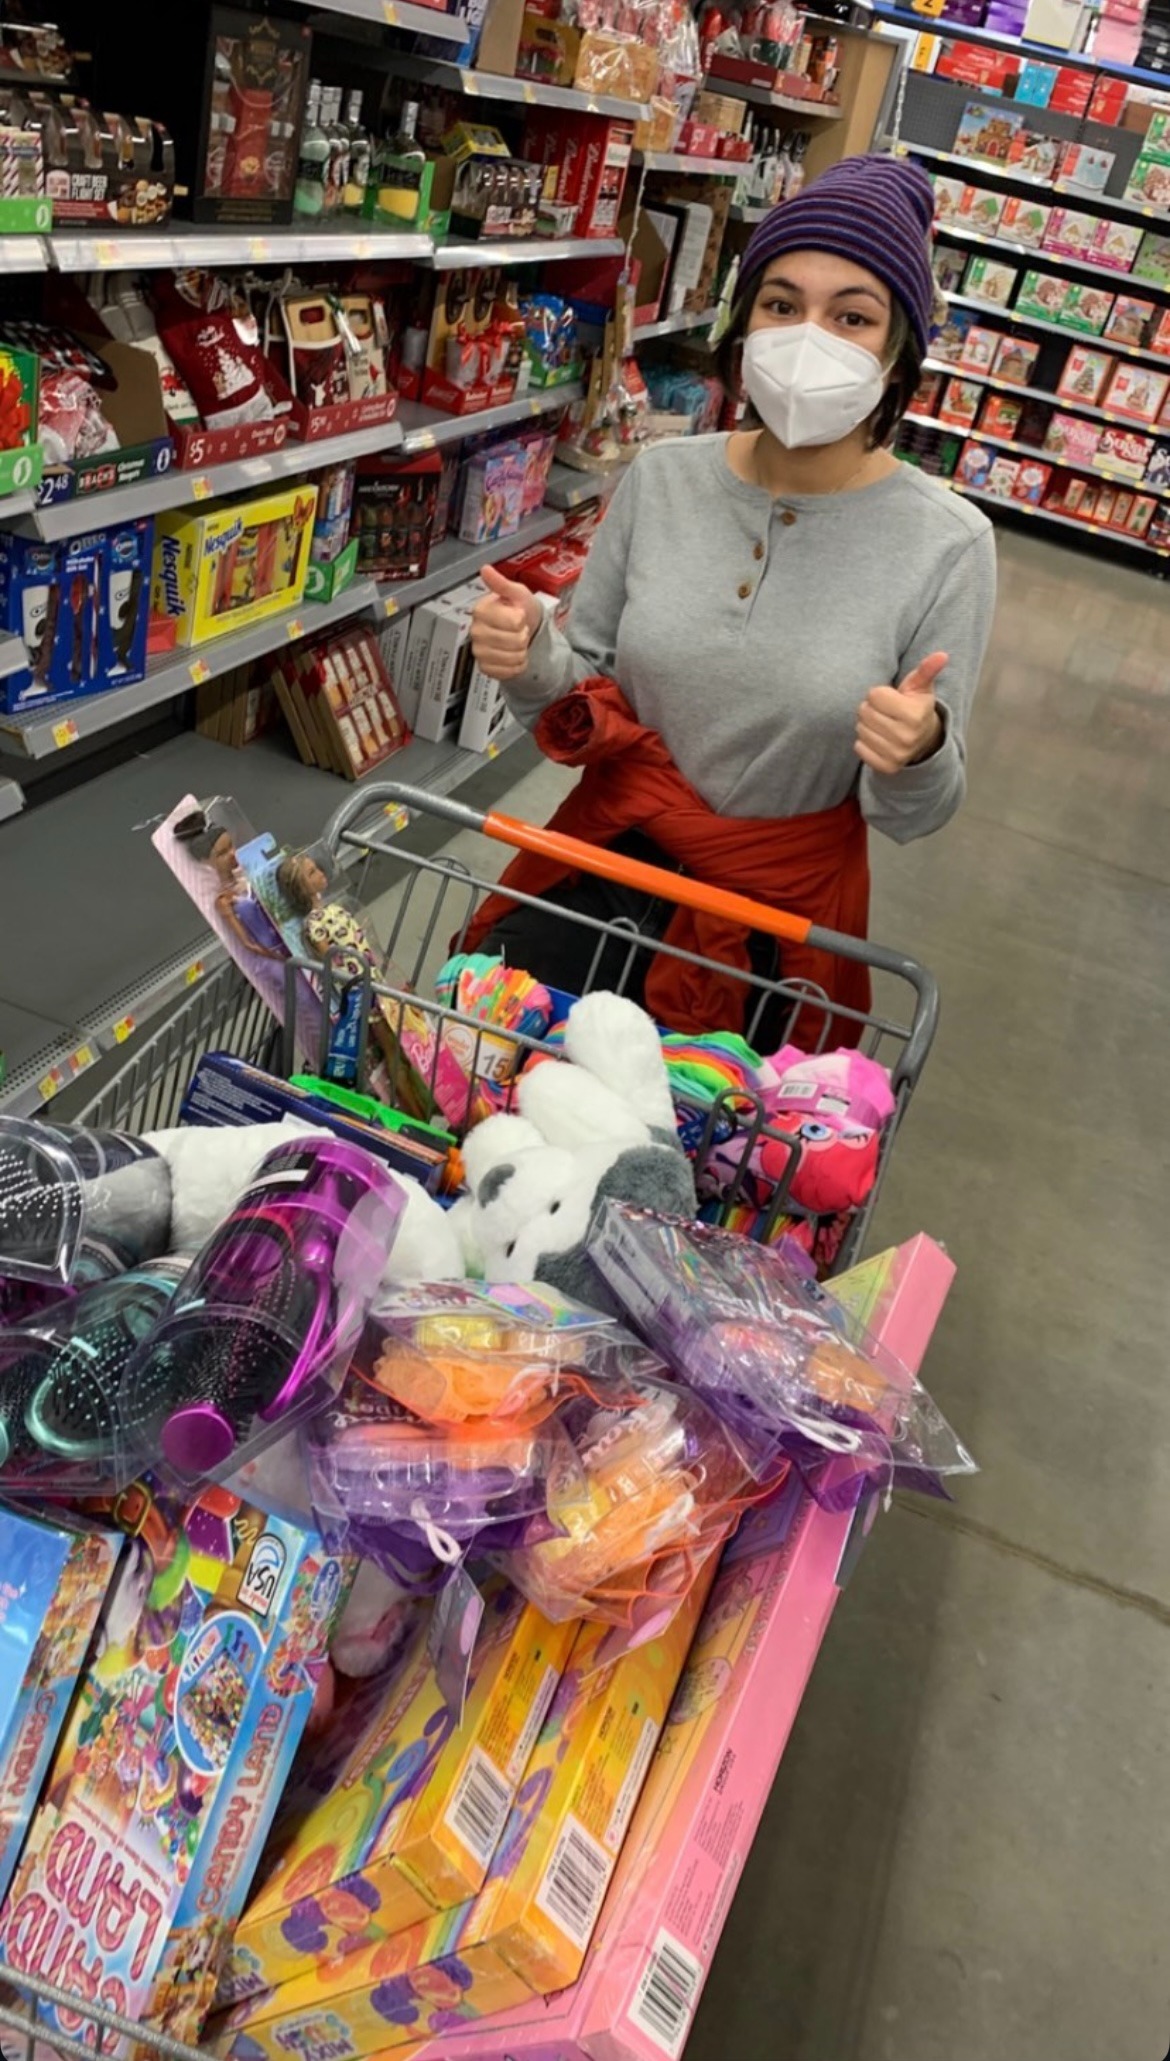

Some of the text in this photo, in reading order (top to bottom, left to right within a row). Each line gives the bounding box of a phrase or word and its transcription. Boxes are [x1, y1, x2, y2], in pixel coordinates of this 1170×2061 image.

[189, 437, 206, 464] $5
[204, 517, 244, 556] Nesquik
[158, 535, 186, 617] Nesquik
[482, 1053, 511, 1081] 15
[245, 1563, 277, 1600] USA
[197, 1703, 283, 1913] CANDY LAND
[45, 1821, 164, 1983] LAND
